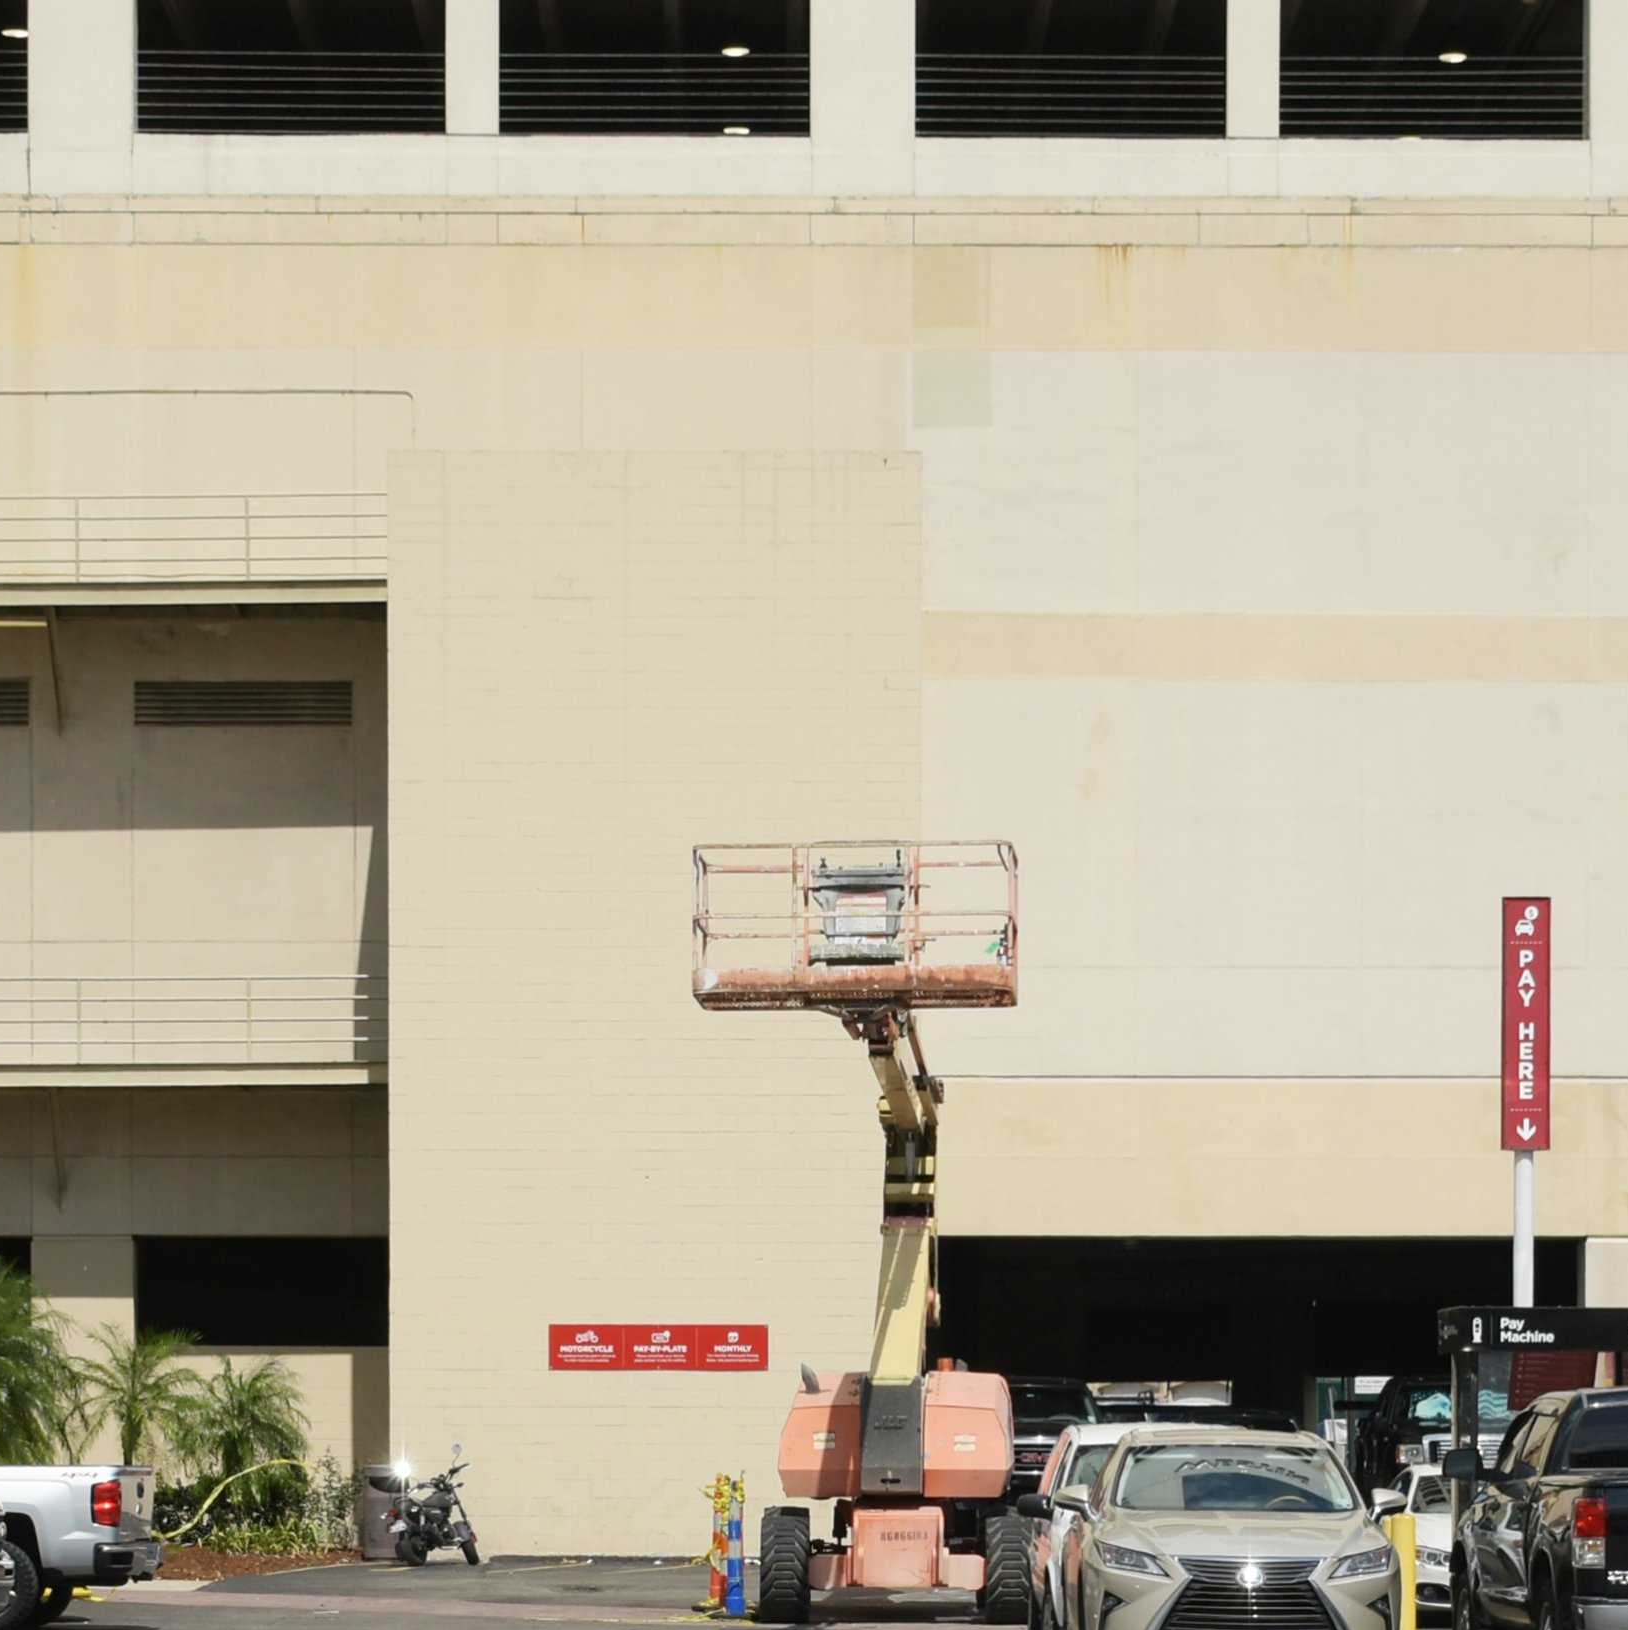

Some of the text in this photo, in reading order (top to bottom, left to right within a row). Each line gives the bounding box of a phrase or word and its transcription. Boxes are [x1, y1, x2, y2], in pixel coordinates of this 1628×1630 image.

[1517, 949, 1536, 1007] PAY
[1518, 1022, 1534, 1100] HERE
[1500, 1317, 1525, 1331] Pay
[1500, 1330, 1555, 1344] Machine
[559, 1345, 614, 1353] MOTORCYCLE
[633, 1345, 688, 1353] PAY-BY-PLATE
[714, 1345, 753, 1353] MONTHLY
